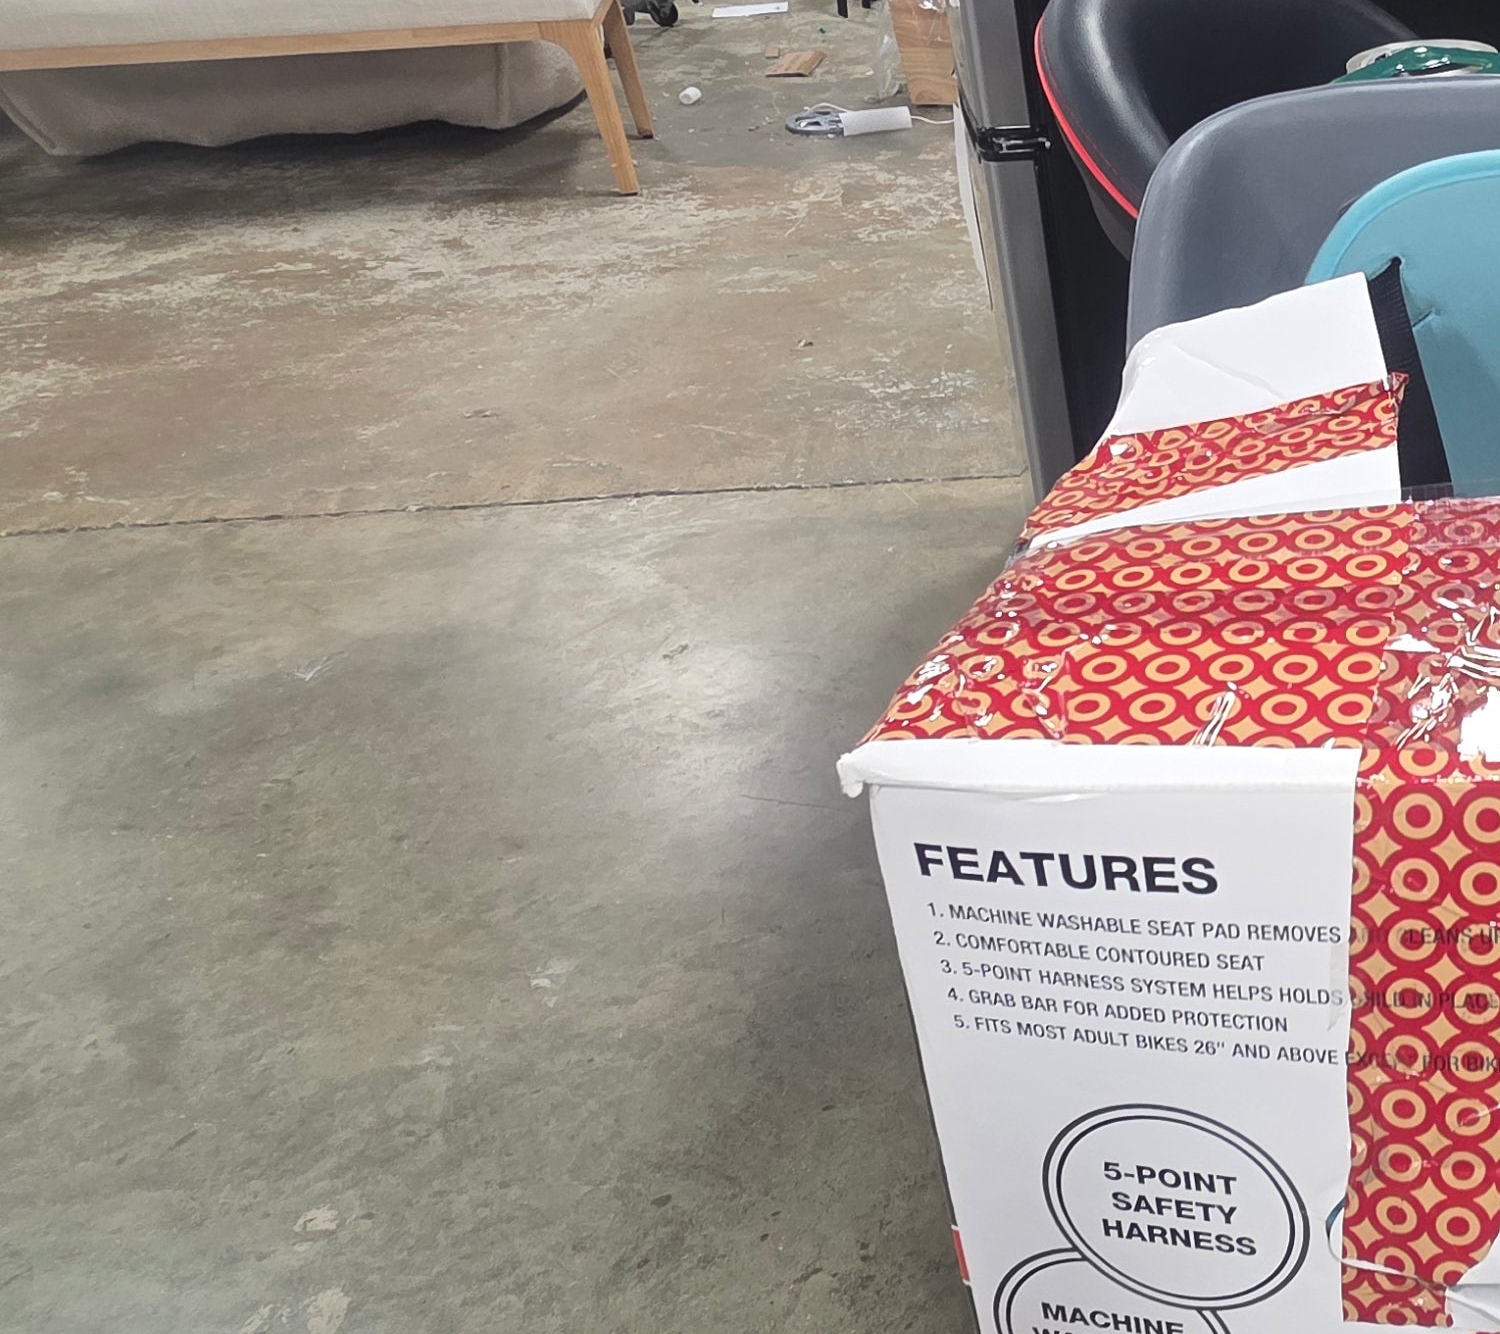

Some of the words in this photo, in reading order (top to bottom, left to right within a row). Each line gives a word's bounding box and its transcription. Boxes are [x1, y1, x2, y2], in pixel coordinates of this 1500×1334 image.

[913, 842, 1219, 895] FEATURES
[927, 902, 944, 918] 1.
[948, 903, 1033, 929] MACHINE
[1037, 912, 1142, 936] WASHABLE
[1147, 919, 1196, 939] SEAT
[1201, 922, 1241, 941] PAD
[1247, 924, 1342, 944] REMOVES
[933, 930, 952, 948] 2.
[955, 932, 1091, 961] COMFORTABLE
[1095, 945, 1211, 970] CONTOURED
[1216, 952, 1265, 972] SEAT
[940, 959, 958, 977] 3.
[962, 961, 1034, 984] 5-POINT
[1038, 968, 1125, 992] HARNESS
[1130, 976, 1208, 1000] SYSTEM
[1212, 982, 1274, 1005] HELPS
[1279, 987, 1344, 1007] HOLDS
[1412, 992, 1432, 1009] IN
[947, 986, 964, 1005] 4.
[968, 988, 1017, 1010] GRAB
[1022, 994, 1059, 1014] BAR
[1063, 998, 1100, 1018] FOR
[1104, 1001, 1167, 1025] ADDED
[1171, 1008, 1289, 1034] PROTECTION
[953, 1014, 971, 1032] 5.
[974, 1016, 1013, 1036] FITS
[1017, 1021, 1068, 1043] MOST
[1072, 1026, 1131, 1050] ADULT
[1135, 1033, 1189, 1055] BIKES
[1193, 1039, 1226, 1057] 26"
[1231, 1041, 1272, 1061] AND
[1276, 1045, 1340, 1066] ABOVE
[1422, 1054, 1460, 1073] FOR
[1103, 1160, 1238, 1195] 5-POINT
[1111, 1191, 1238, 1225] SAFETY
[1101, 1218, 1258, 1256] HARNESS
